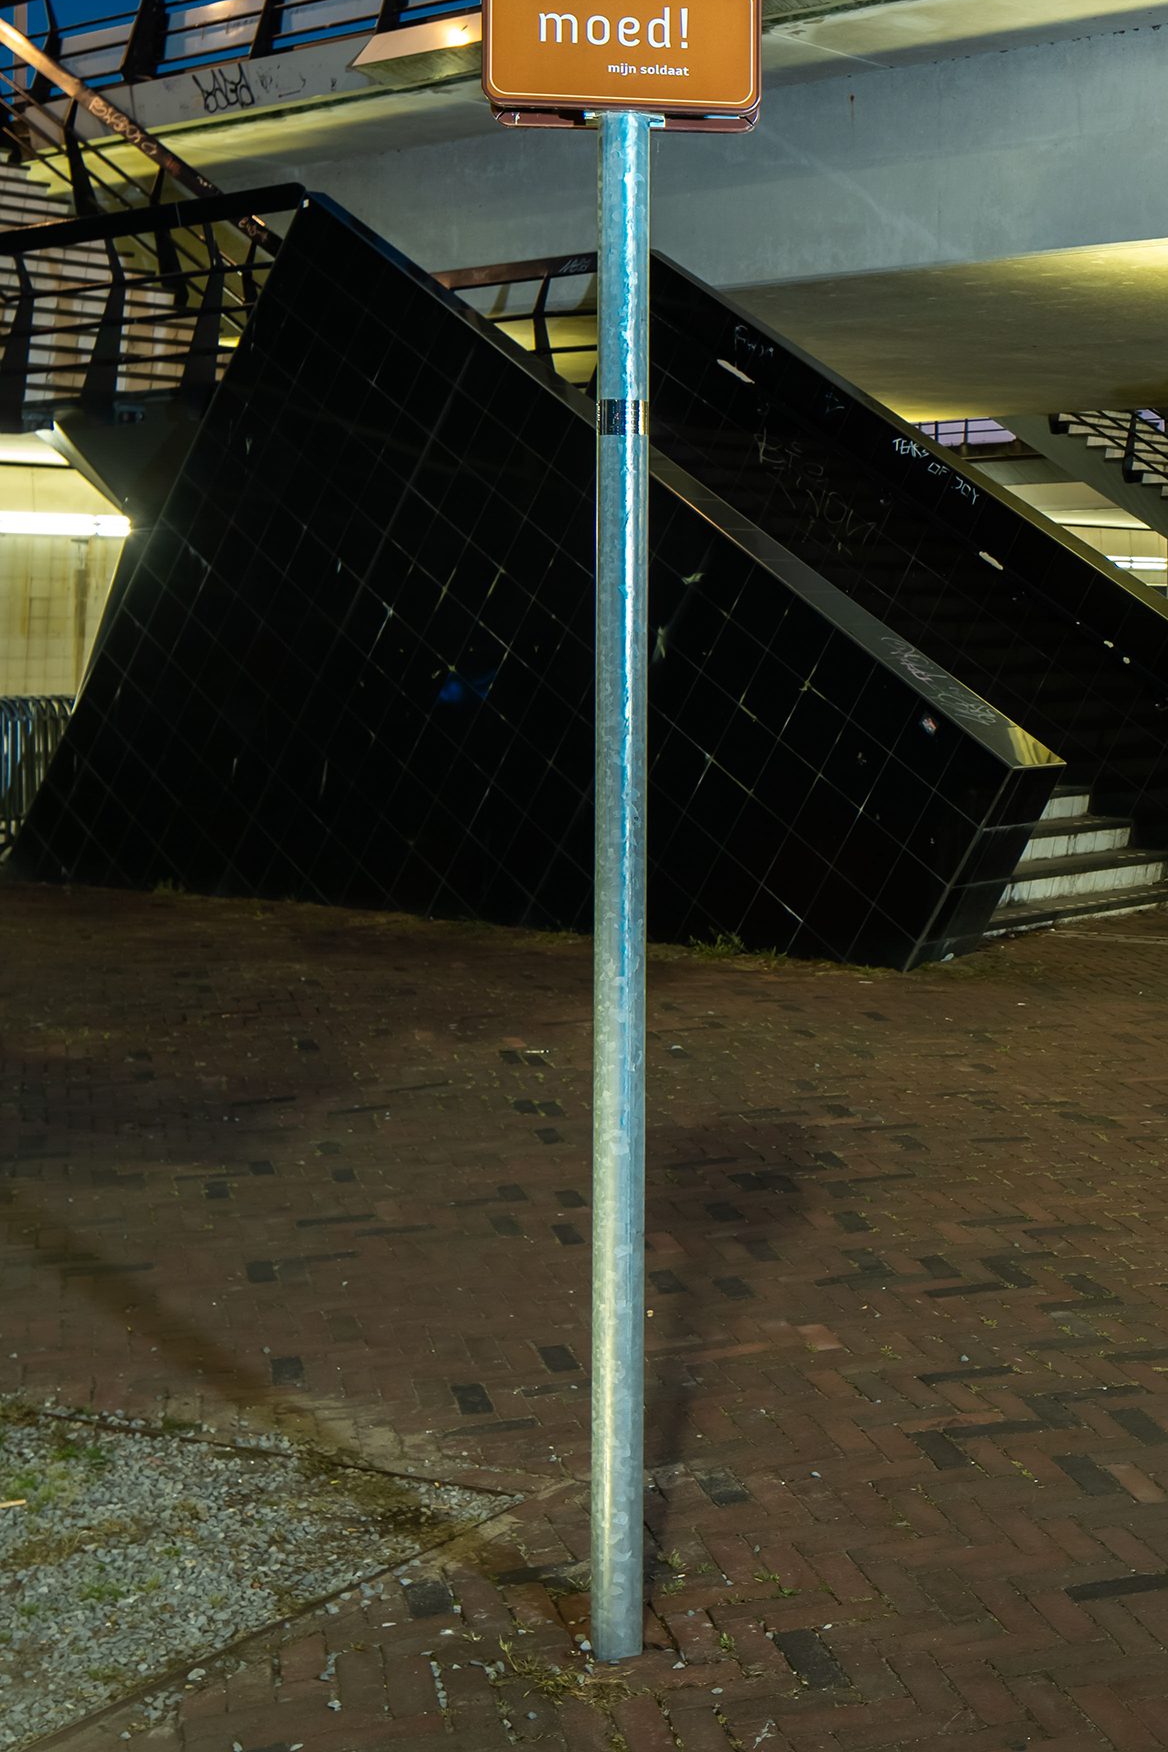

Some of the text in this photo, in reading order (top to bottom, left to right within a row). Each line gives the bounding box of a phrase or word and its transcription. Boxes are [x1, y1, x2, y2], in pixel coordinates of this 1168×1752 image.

[538, 6, 689, 49] moed!
[607, 62, 690, 77] mijn soldaat
[927, 461, 951, 476] OF
